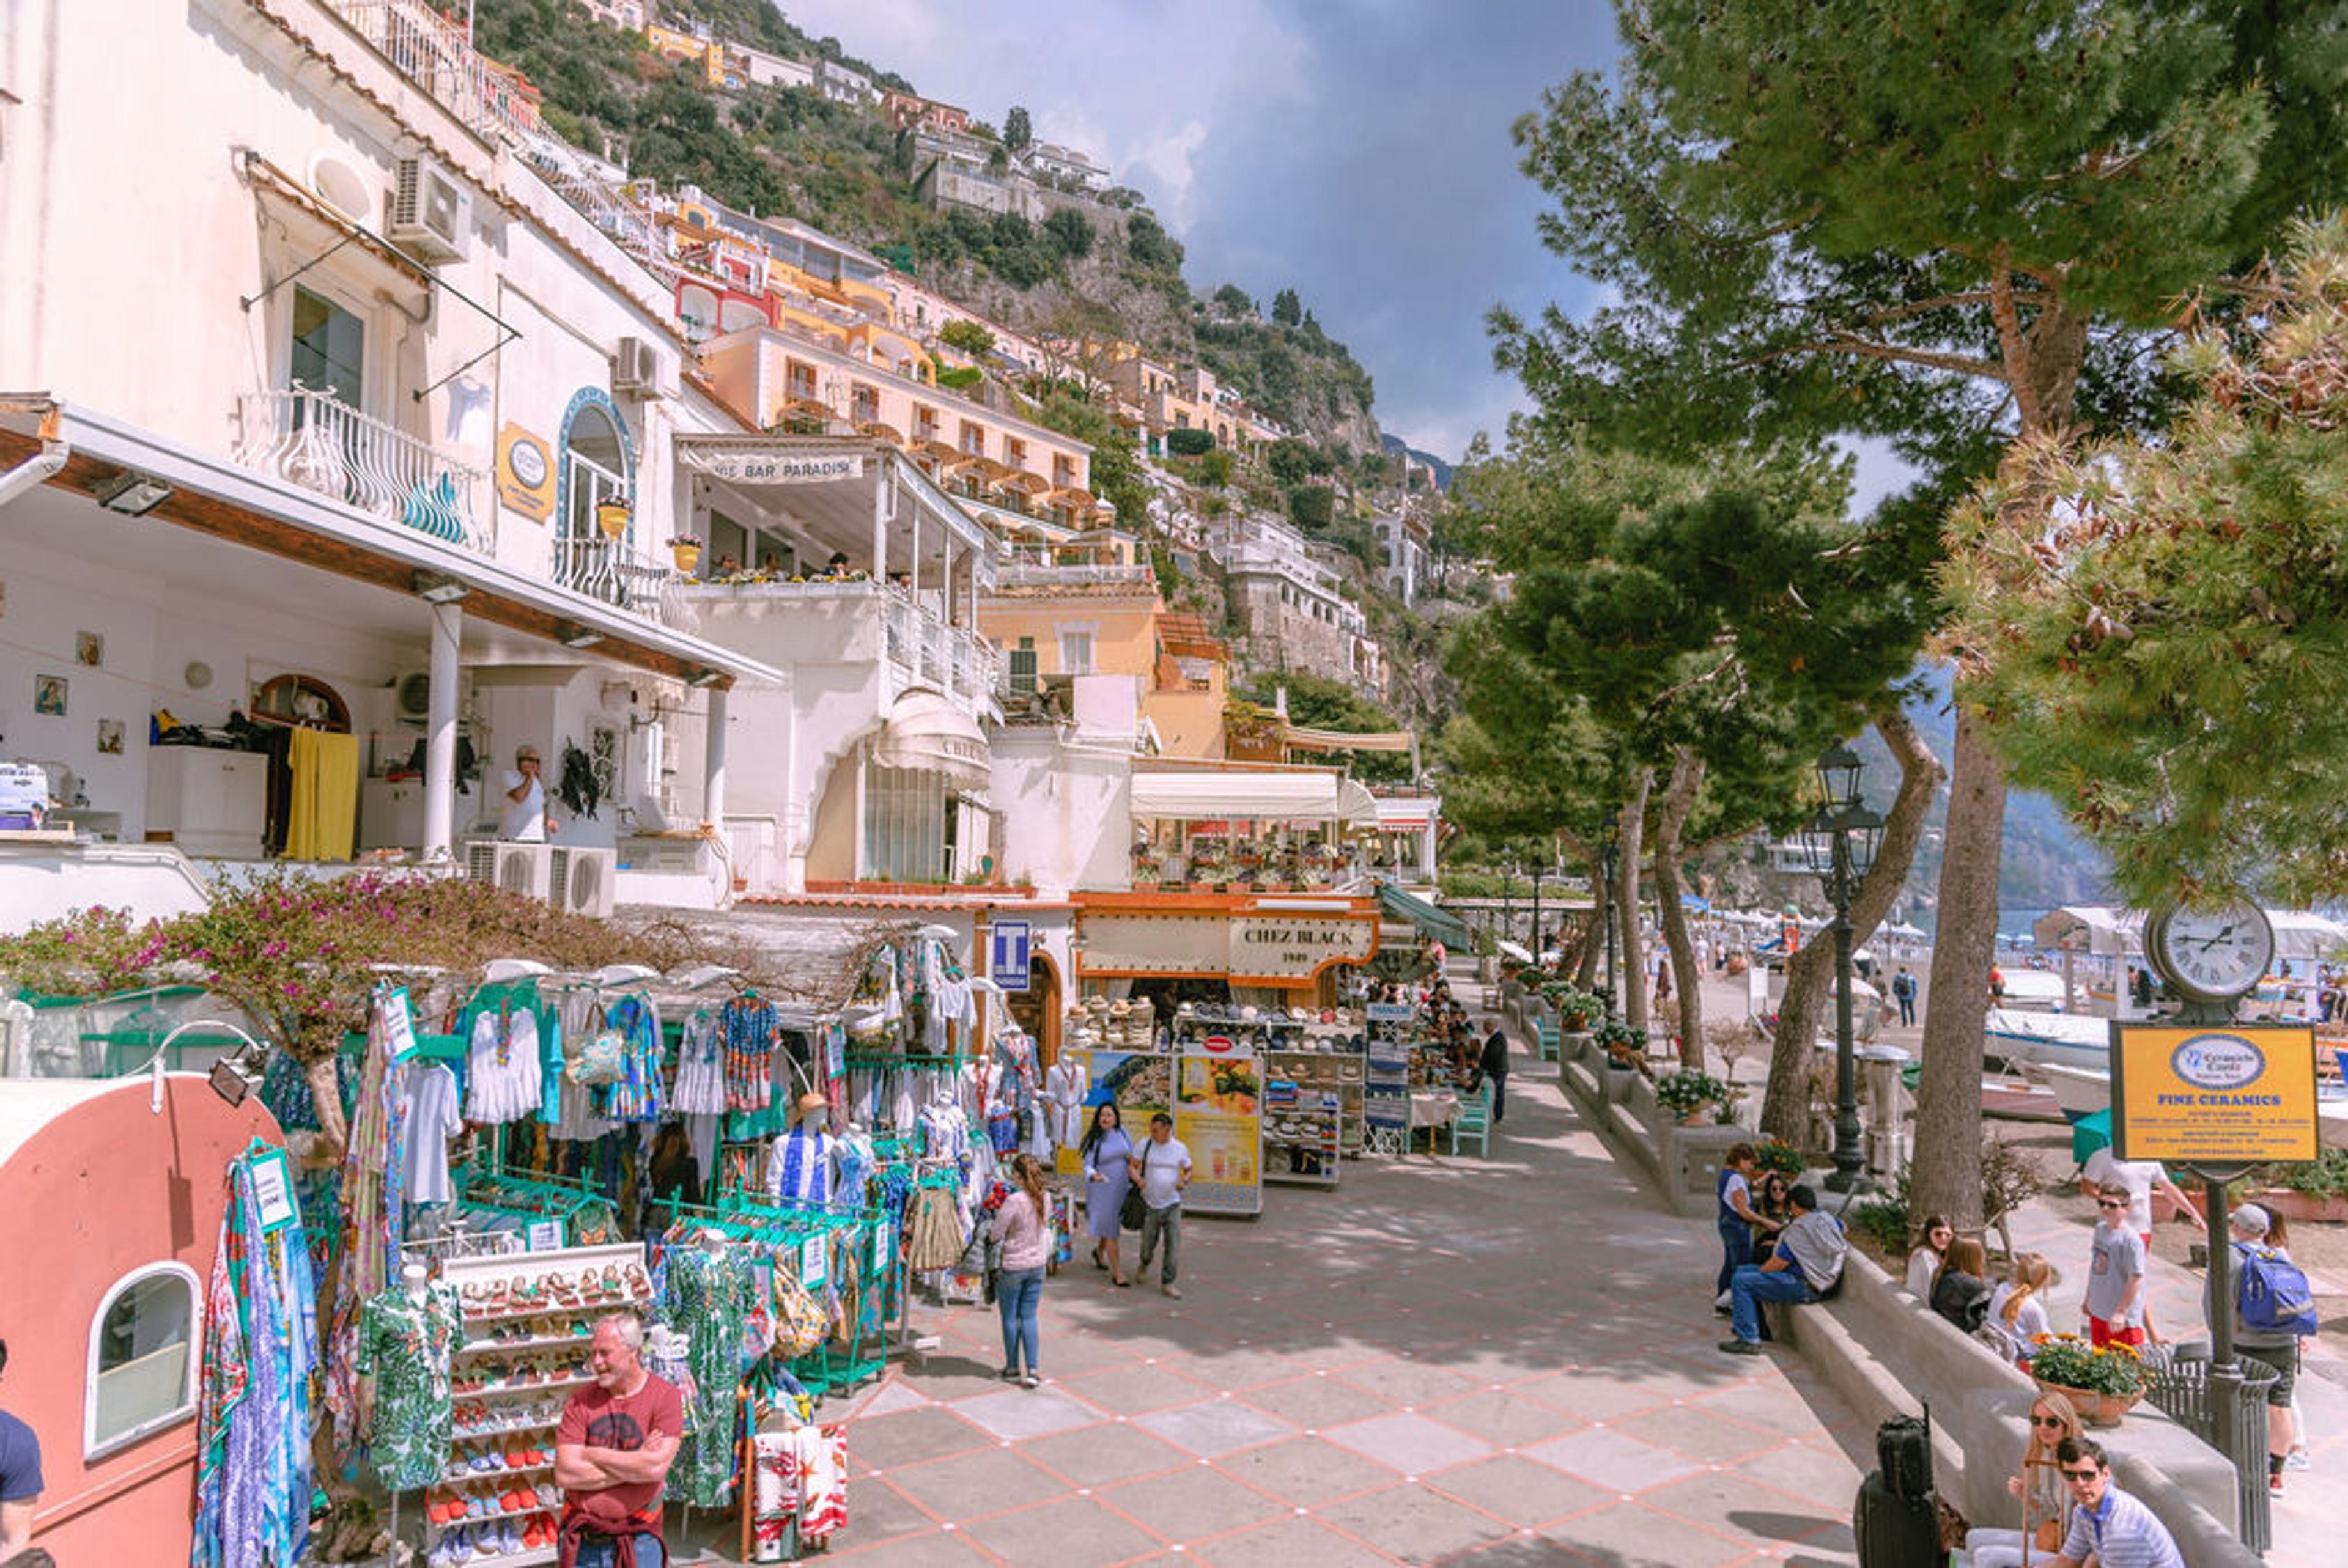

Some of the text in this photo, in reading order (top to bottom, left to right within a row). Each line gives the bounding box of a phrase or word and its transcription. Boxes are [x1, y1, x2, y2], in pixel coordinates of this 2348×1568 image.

[745, 465, 775, 477] BAR
[783, 462, 851, 477] PARADISE
[1244, 929, 1352, 945] CHEZ BLACK
[2157, 1094, 2282, 1106] FINE CERAMICS
